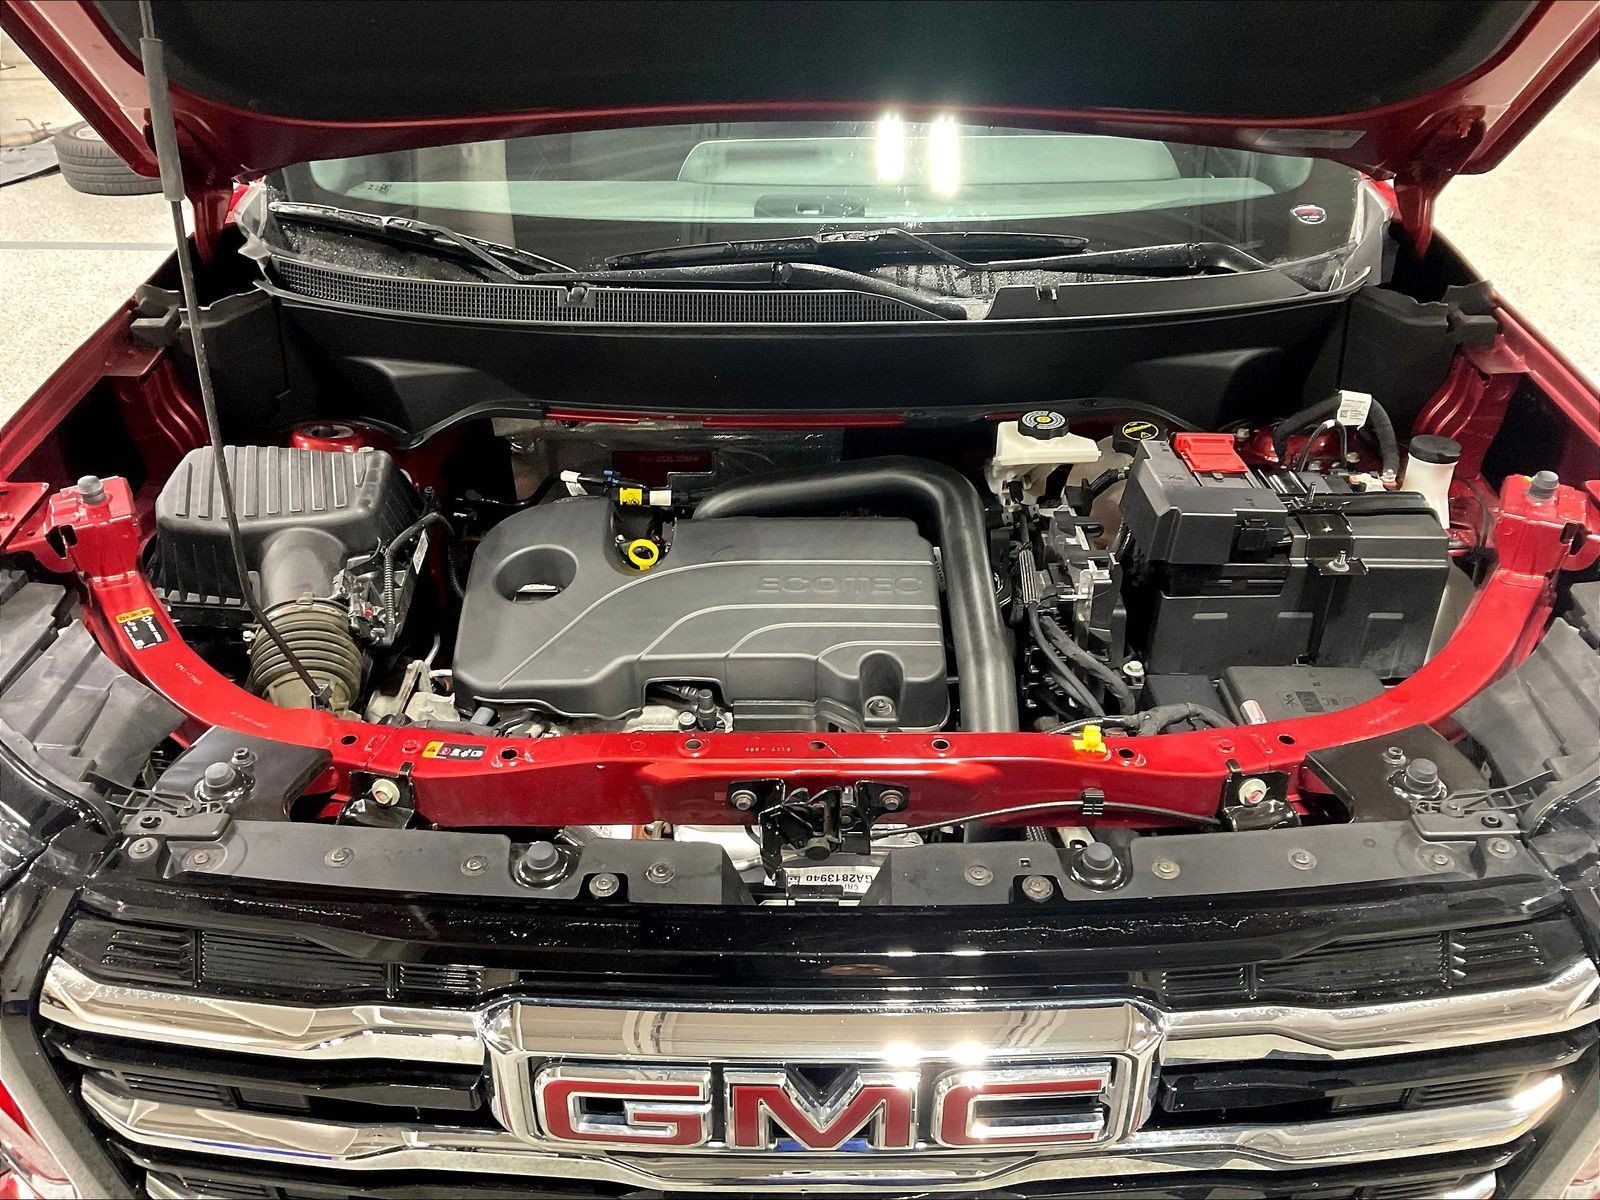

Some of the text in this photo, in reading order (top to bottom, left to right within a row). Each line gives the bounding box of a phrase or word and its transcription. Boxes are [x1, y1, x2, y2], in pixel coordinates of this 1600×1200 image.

[756, 577, 922, 594] ECOTEC
[806, 874, 873, 883] GA2813940
[537, 1064, 1110, 1149] GMC
